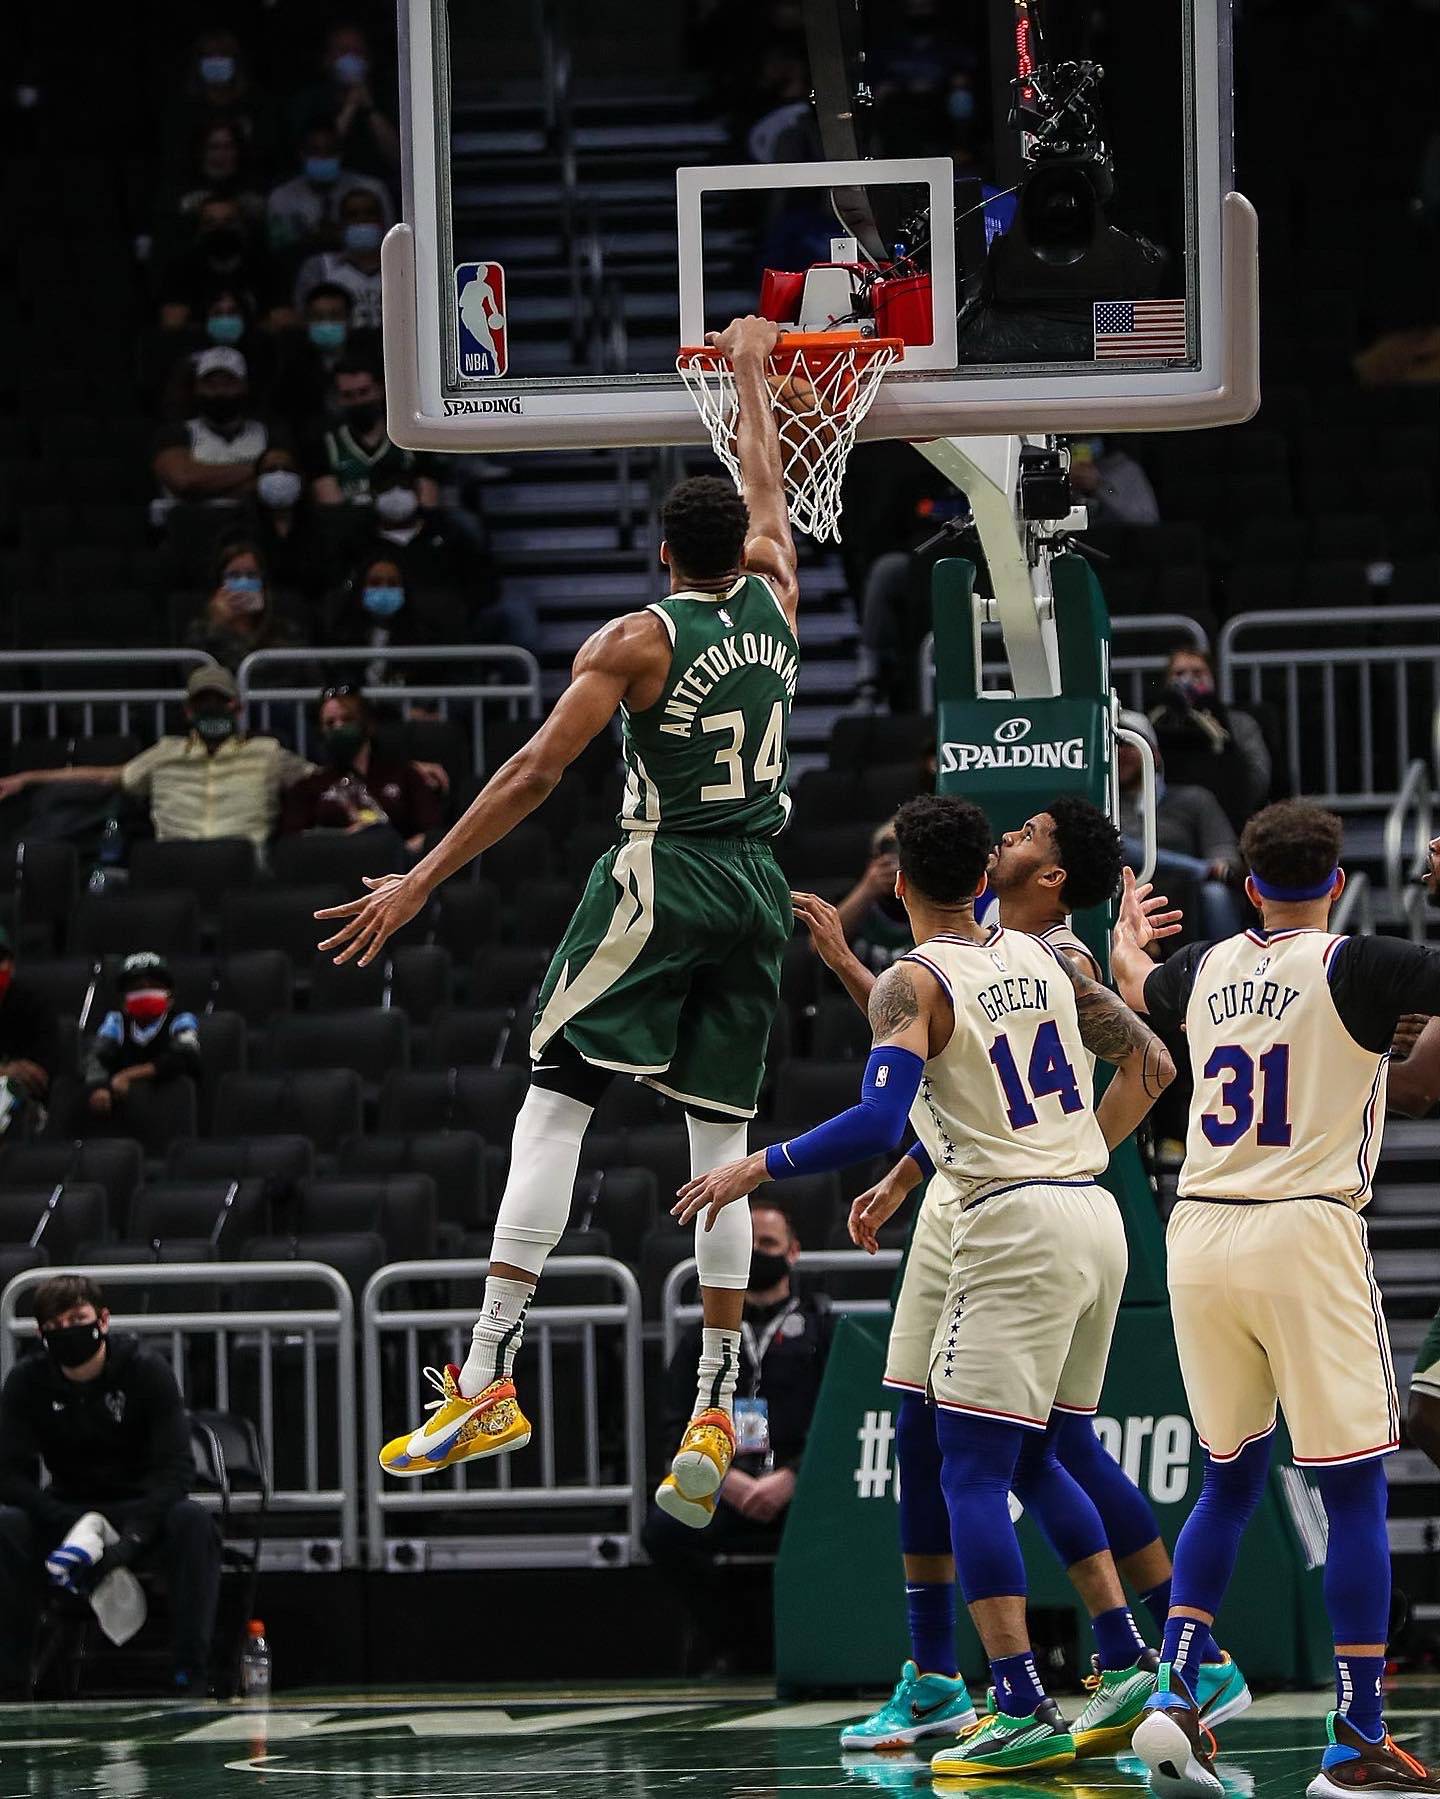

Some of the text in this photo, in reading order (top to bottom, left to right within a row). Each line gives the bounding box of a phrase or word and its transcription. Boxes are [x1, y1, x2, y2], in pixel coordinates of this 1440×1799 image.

[465, 352, 489, 371] NBA
[443, 397, 521, 417] SPALDING
[701, 701, 783, 801] 34
[941, 738, 1084, 774] SPALDING
[977, 978, 1048, 1023] GREEN
[1207, 981, 1300, 1026] CURRY
[988, 1019, 1085, 1131] 14
[1201, 1043, 1292, 1148] 31
